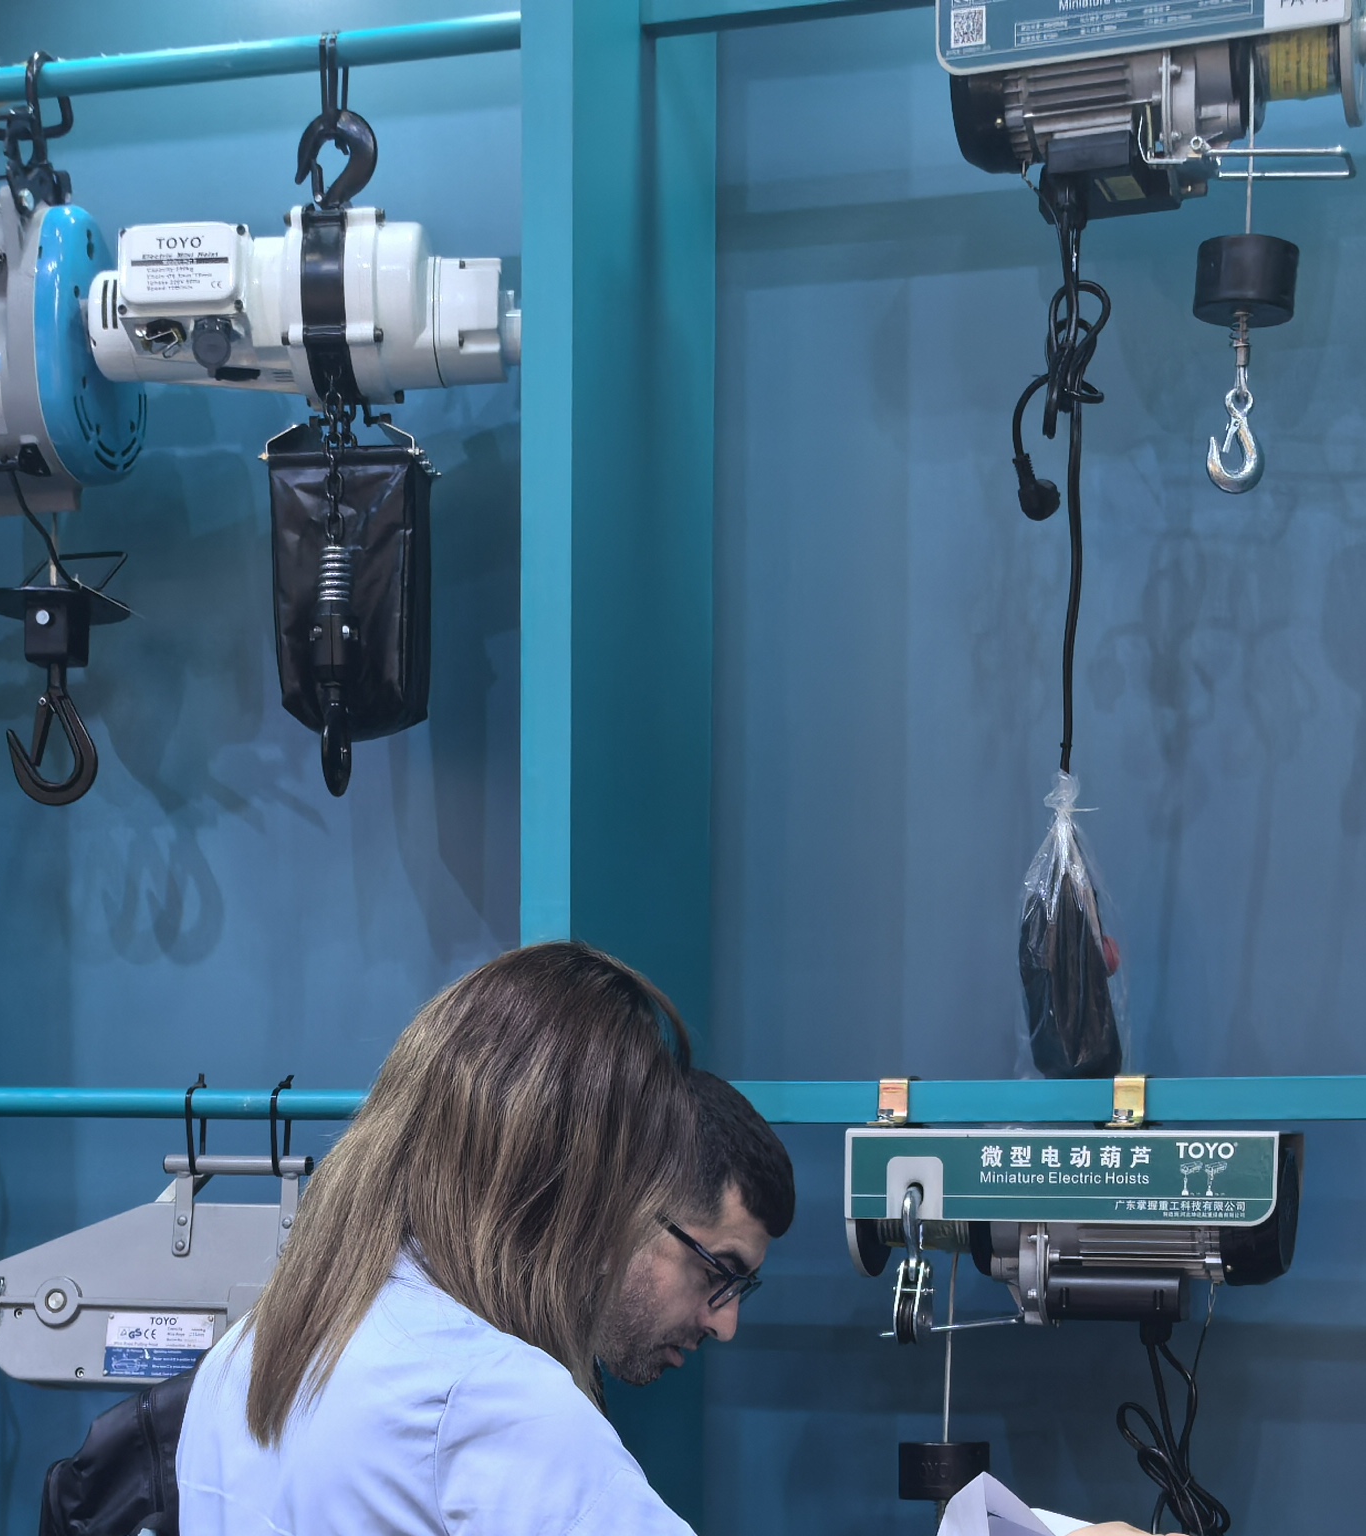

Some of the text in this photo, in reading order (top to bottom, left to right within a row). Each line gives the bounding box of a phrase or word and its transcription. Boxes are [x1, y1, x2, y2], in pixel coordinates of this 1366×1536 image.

[156, 236, 202, 249] TOYO
[980, 1145, 1152, 1168] 微型电动葫芦
[1176, 1142, 1235, 1160] TOYO
[980, 1171, 1150, 1185] Miniature Electric Hoists
[150, 1317, 178, 1326] TOYO
